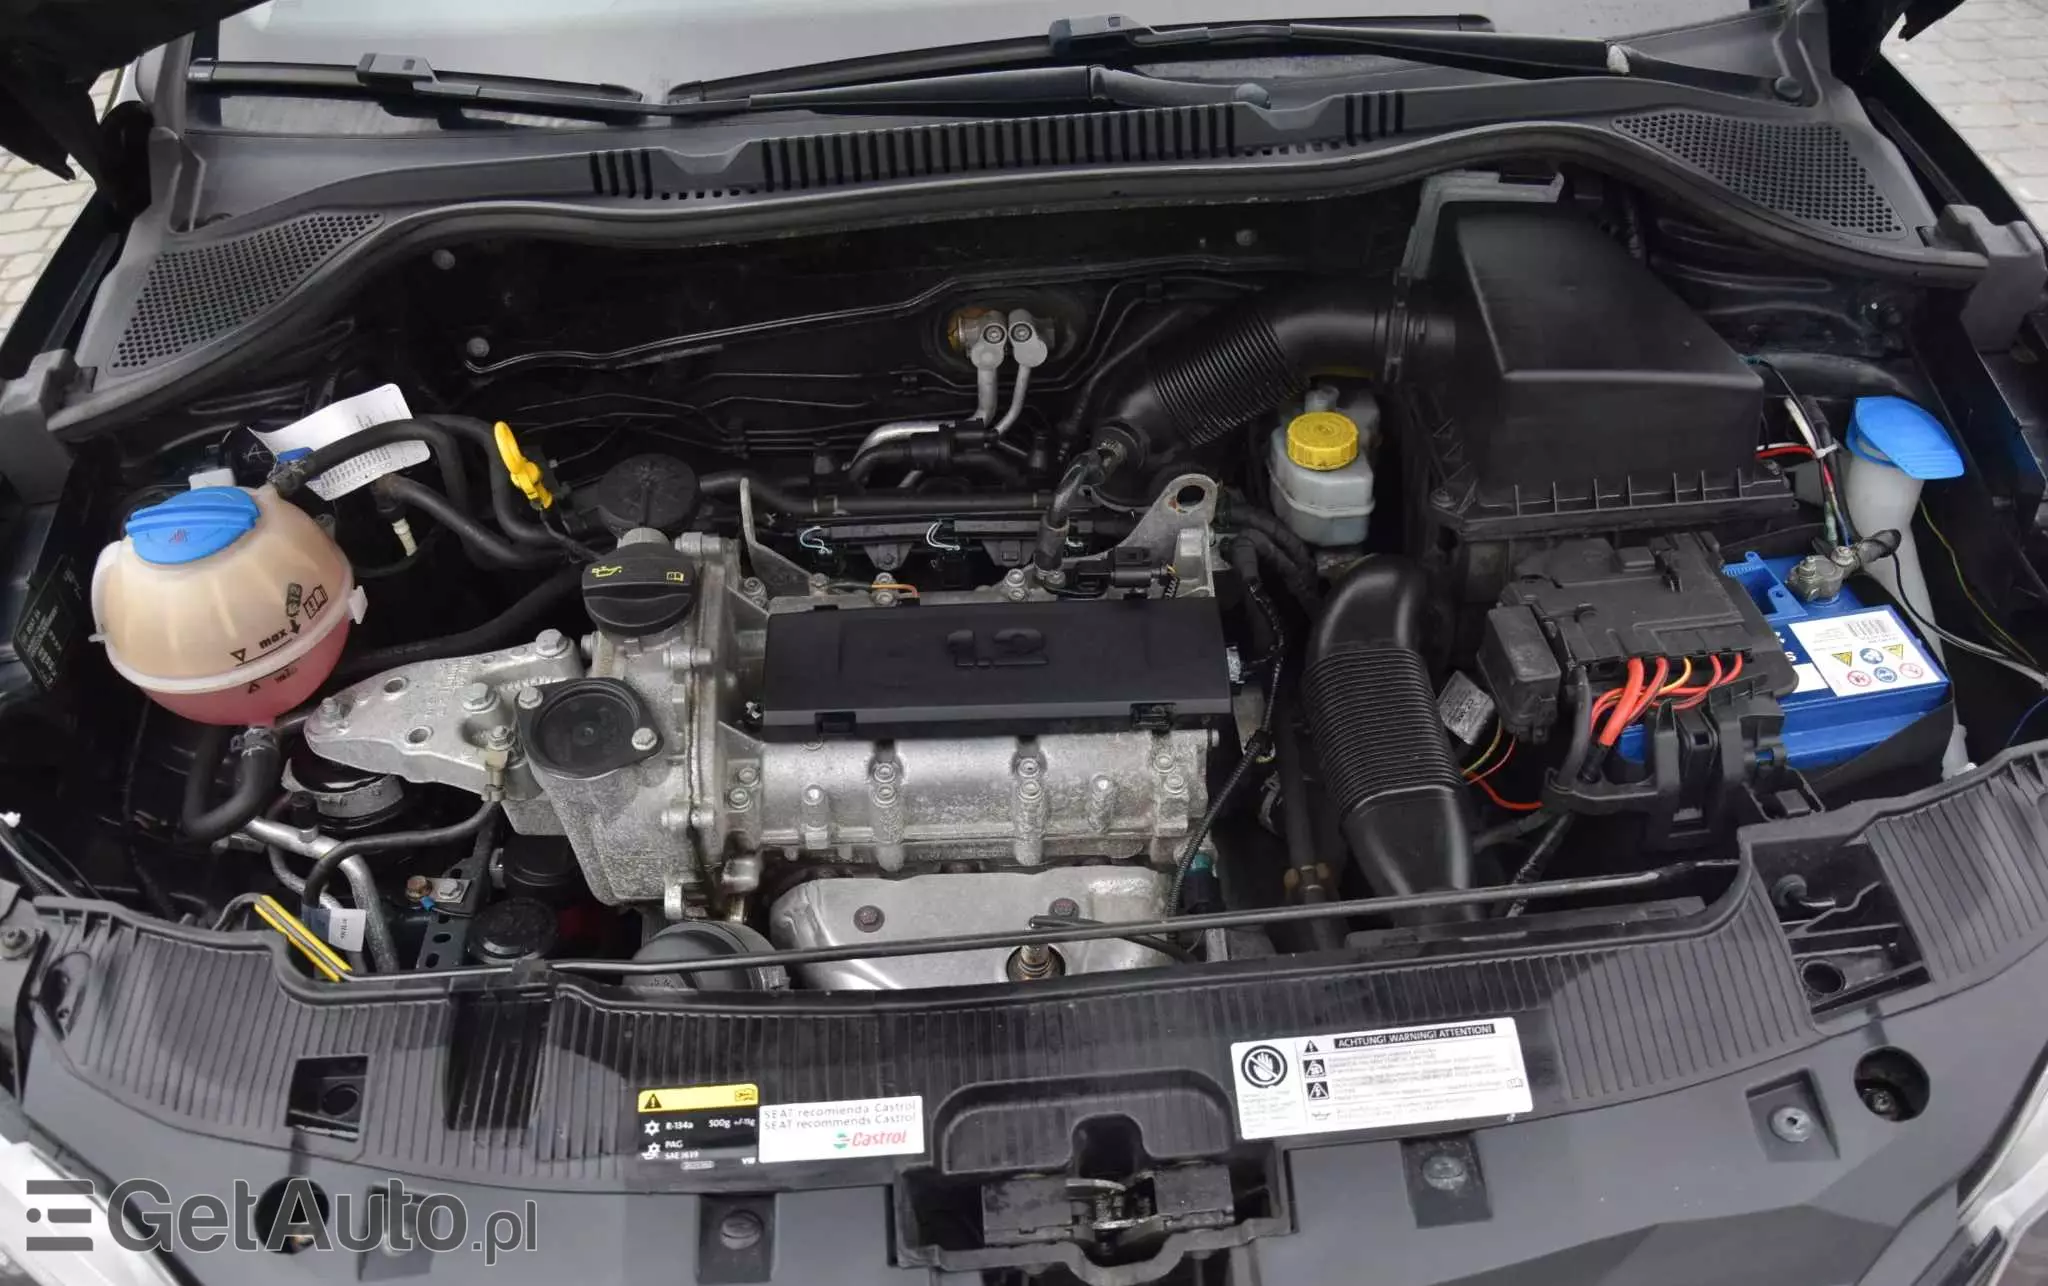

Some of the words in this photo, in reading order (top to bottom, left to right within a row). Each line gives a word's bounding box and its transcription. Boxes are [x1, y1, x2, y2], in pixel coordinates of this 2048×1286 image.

[259, 628, 288, 649] max
[1338, 1036, 1387, 1048] ACHTUNG!
[1389, 1030, 1437, 1043] WARNING!
[1439, 1024, 1493, 1038] ATTENTION!
[764, 1108, 793, 1119] SEAT
[798, 1105, 870, 1118] recomienda
[874, 1100, 916, 1114] Castrol
[708, 1118, 731, 1129] 500g
[764, 1119, 792, 1131] SEAT
[797, 1115, 871, 1129] recommends
[875, 1112, 916, 1125] Castrol
[665, 1140, 683, 1149] PAG
[852, 1130, 907, 1147] Castrol
